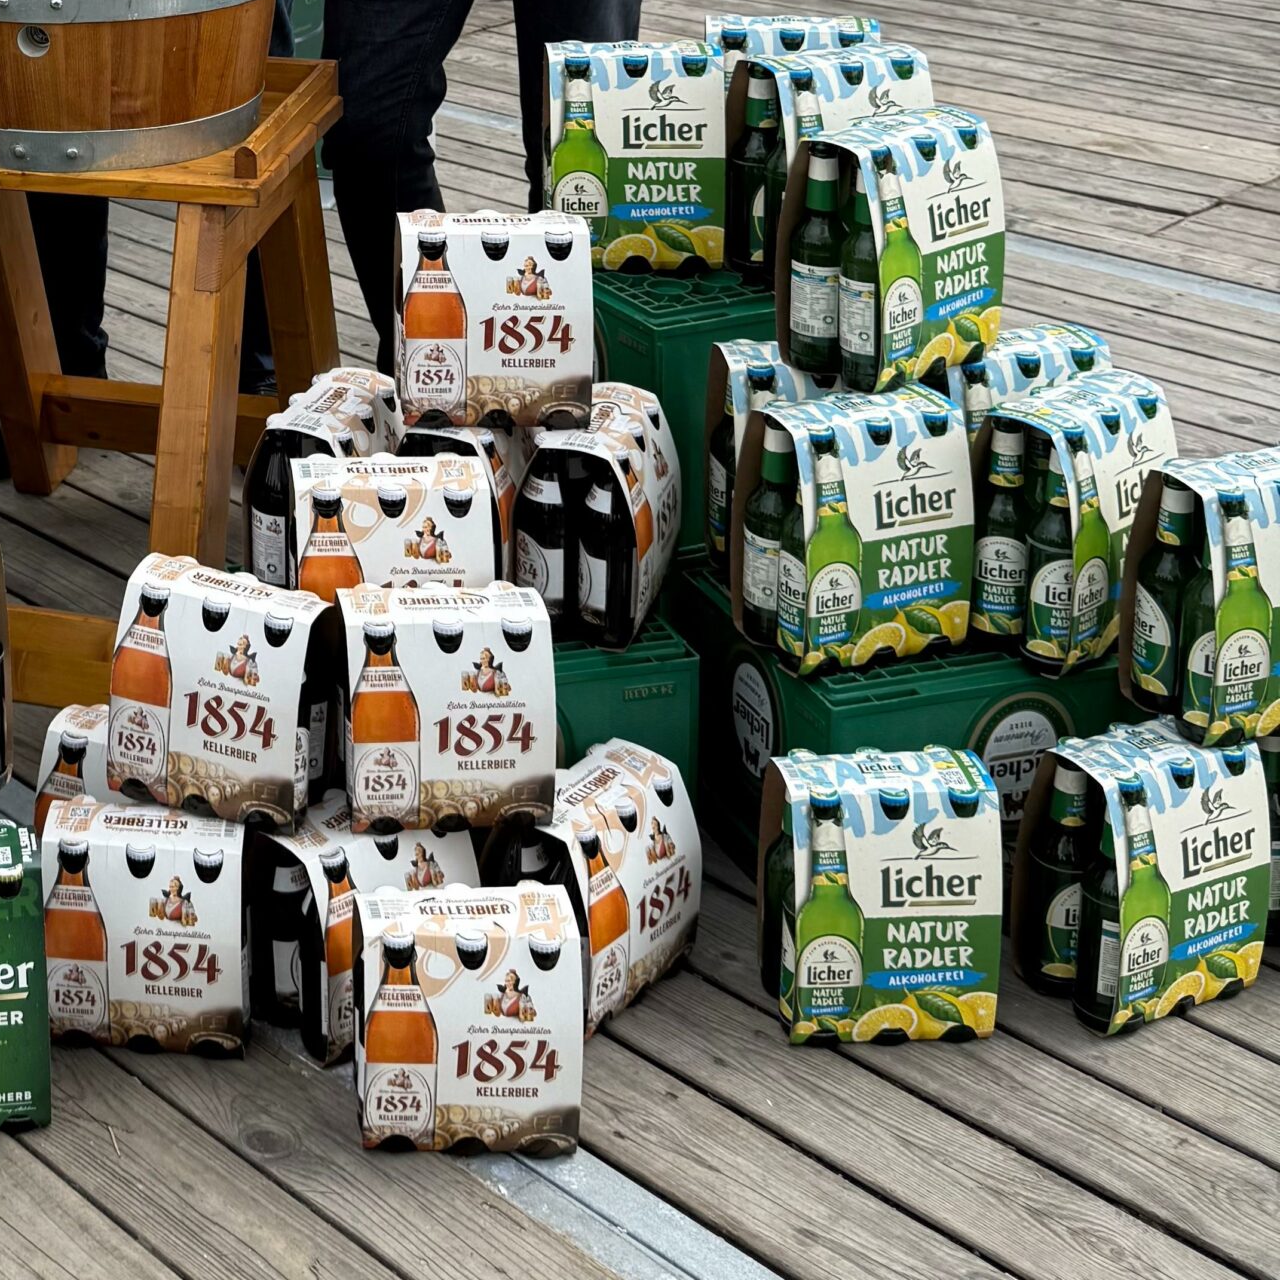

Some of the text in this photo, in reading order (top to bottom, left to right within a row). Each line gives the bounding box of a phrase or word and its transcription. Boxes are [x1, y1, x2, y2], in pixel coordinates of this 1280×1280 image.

[621, 114, 708, 150] Licher
[627, 161, 698, 182] NATUR
[623, 184, 702, 204] RADLER
[629, 205, 695, 220] ALKOHOLFREI
[926, 194, 992, 243] Licher
[936, 242, 987, 275] NATUR
[935, 266, 990, 301] RADLER
[938, 291, 984, 318] ALKOHOLFREI
[479, 315, 575, 355] 1854
[501, 357, 556, 369] KELLERBIER
[873, 480, 957, 531] Licher
[880, 534, 949, 562] NATUR
[877, 556, 952, 589] RADLER
[882, 581, 945, 607] ALKOHOLFREI
[184, 691, 278, 751] 1854
[433, 713, 537, 757] 1854
[202, 739, 258, 764] KELLERBIER
[457, 759, 516, 771] KELLERBIER
[1180, 823, 1255, 879] Licher
[880, 864, 982, 909] Licher
[1187, 876, 1247, 911] NATUR
[418, 903, 511, 917] KELLERBIER
[1183, 901, 1251, 940] RADLER
[887, 921, 970, 943] NATUR
[1186, 924, 1243, 954] ALKOHOLFREI
[120, 940, 224, 986] 1854
[882, 945, 974, 969] RADLER
[144, 984, 203, 999] KELLERBIER
[888, 970, 964, 988] ALKOHOLFREI
[452, 1039, 563, 1083] 1854
[476, 1086, 539, 1098] KELLERBIER
